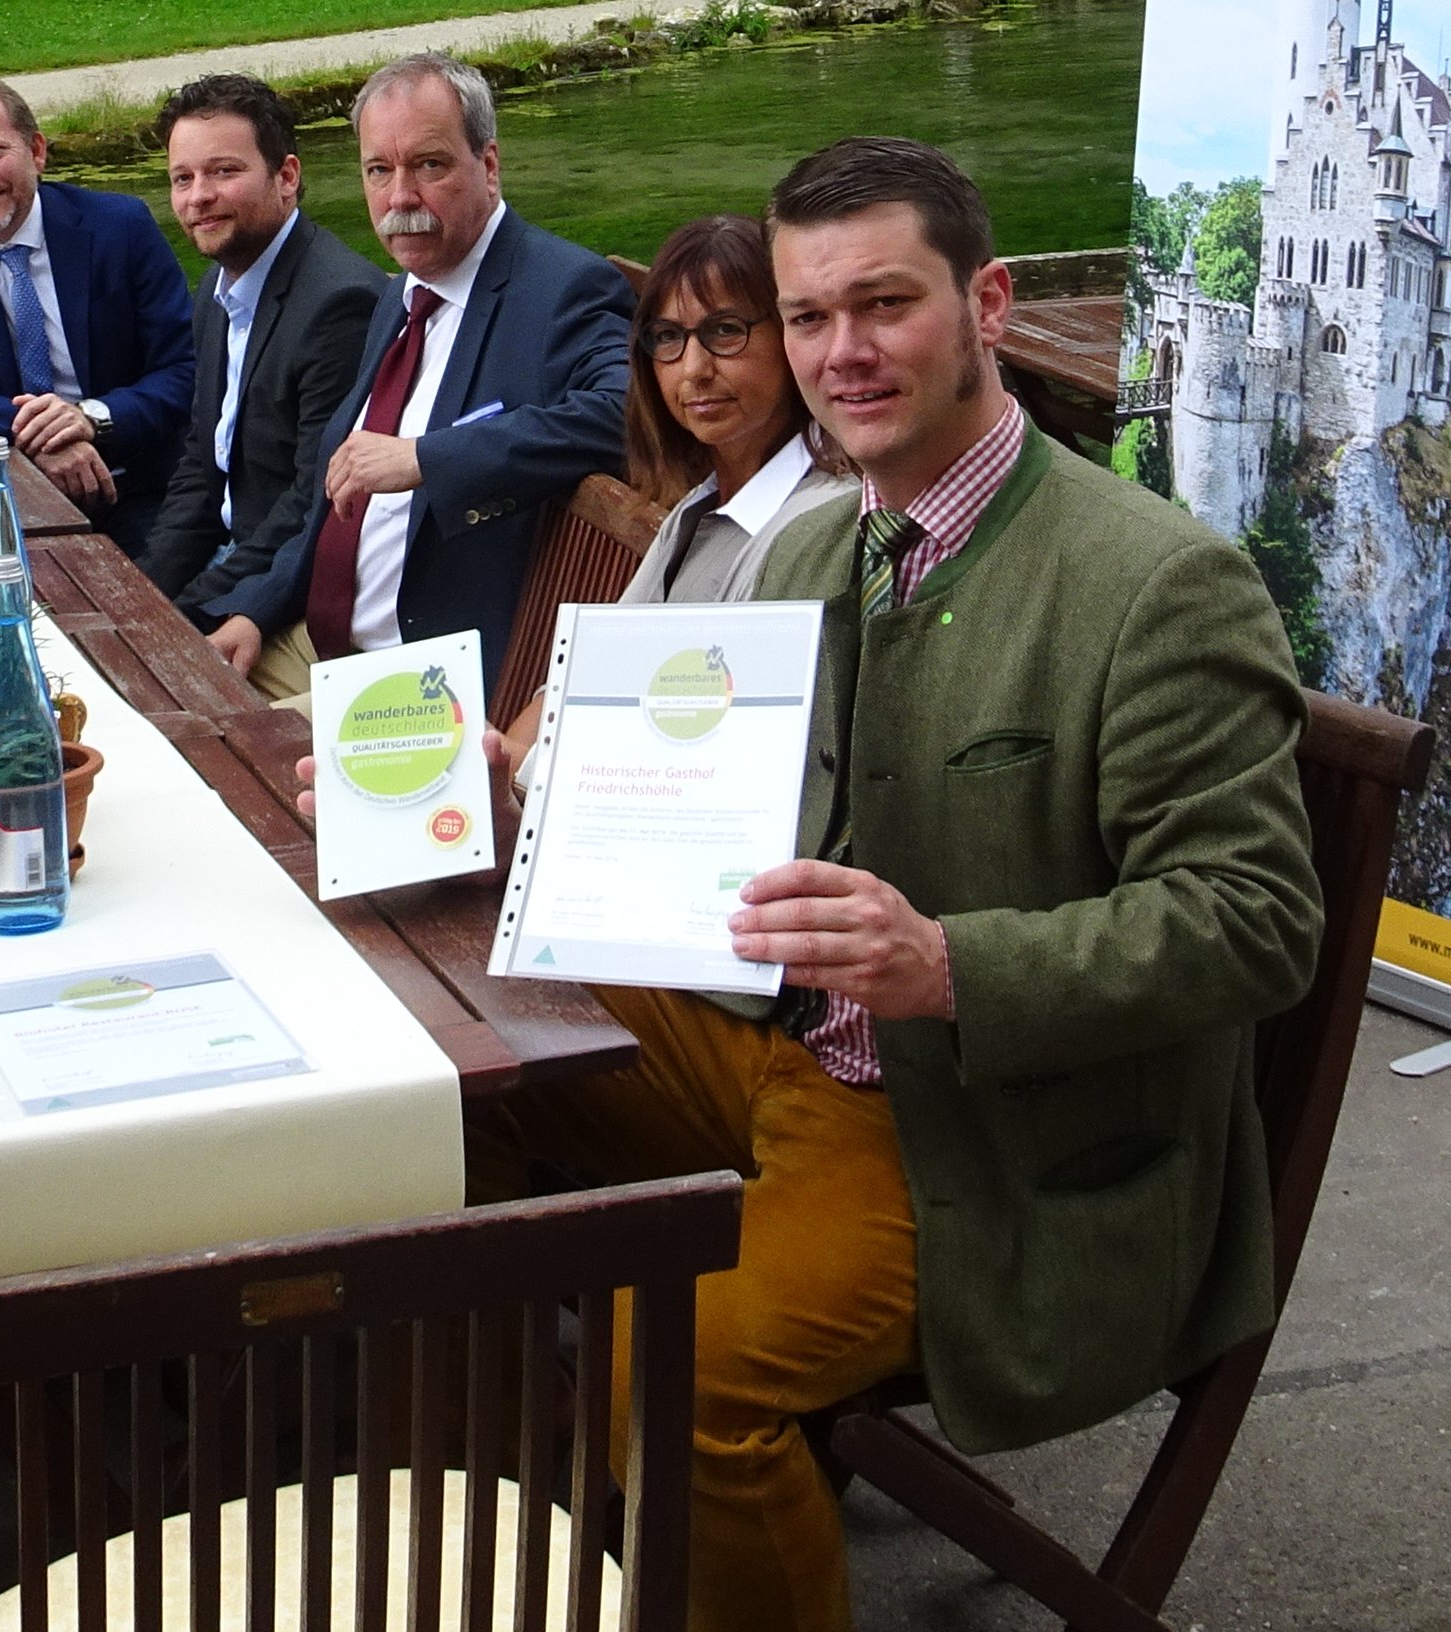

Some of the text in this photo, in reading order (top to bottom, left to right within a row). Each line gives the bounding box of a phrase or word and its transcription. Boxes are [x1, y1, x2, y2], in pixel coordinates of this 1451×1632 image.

[353, 703, 446, 721] wanderbares
[352, 718, 445, 737] deutschland
[352, 737, 444, 753] QUALITÄTSGASTGEBER
[580, 764, 716, 779] Historischer Gasthof
[577, 781, 684, 797] Friedrichshöhle
